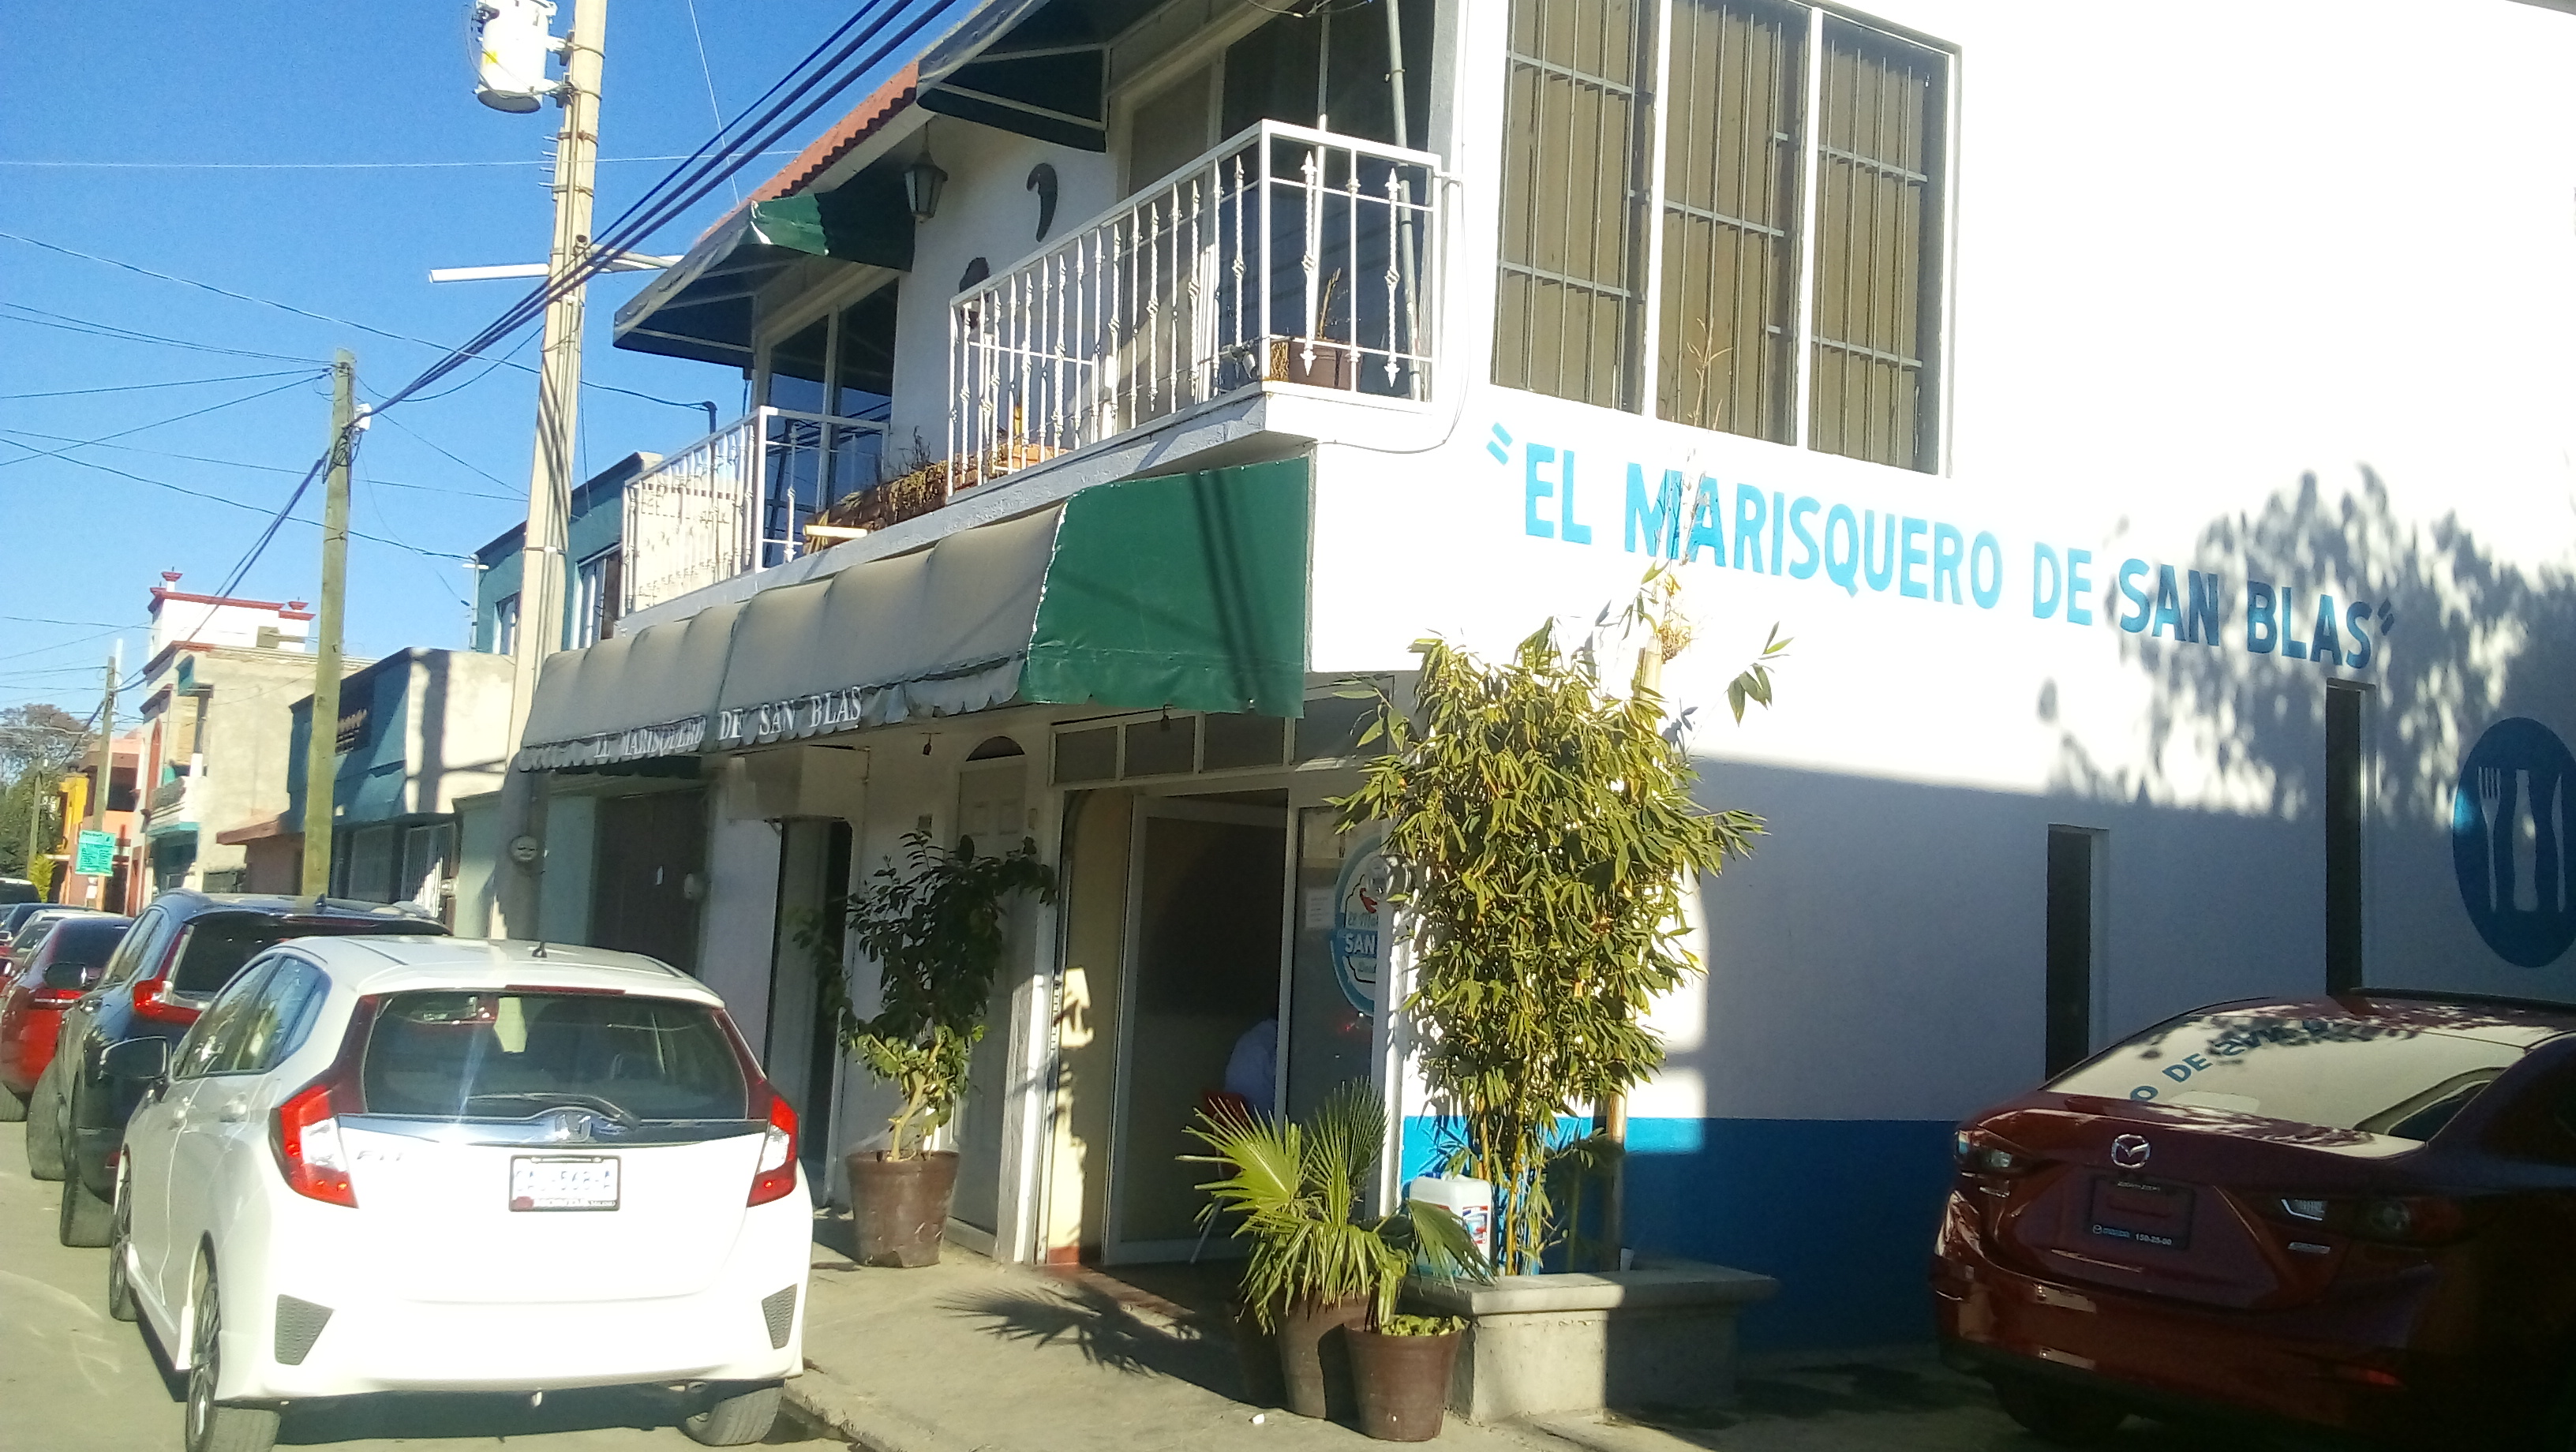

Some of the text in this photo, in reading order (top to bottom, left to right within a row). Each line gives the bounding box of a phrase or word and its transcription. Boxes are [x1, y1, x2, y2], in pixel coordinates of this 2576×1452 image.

[1624, 462, 2002, 609] MARISQUERO
[2032, 541, 2093, 626] DE
[2118, 558, 2219, 646] SAN
[759, 700, 795, 735] SAN
[809, 686, 862, 728] BLAS
[1345, 932, 1376, 955] SAN
